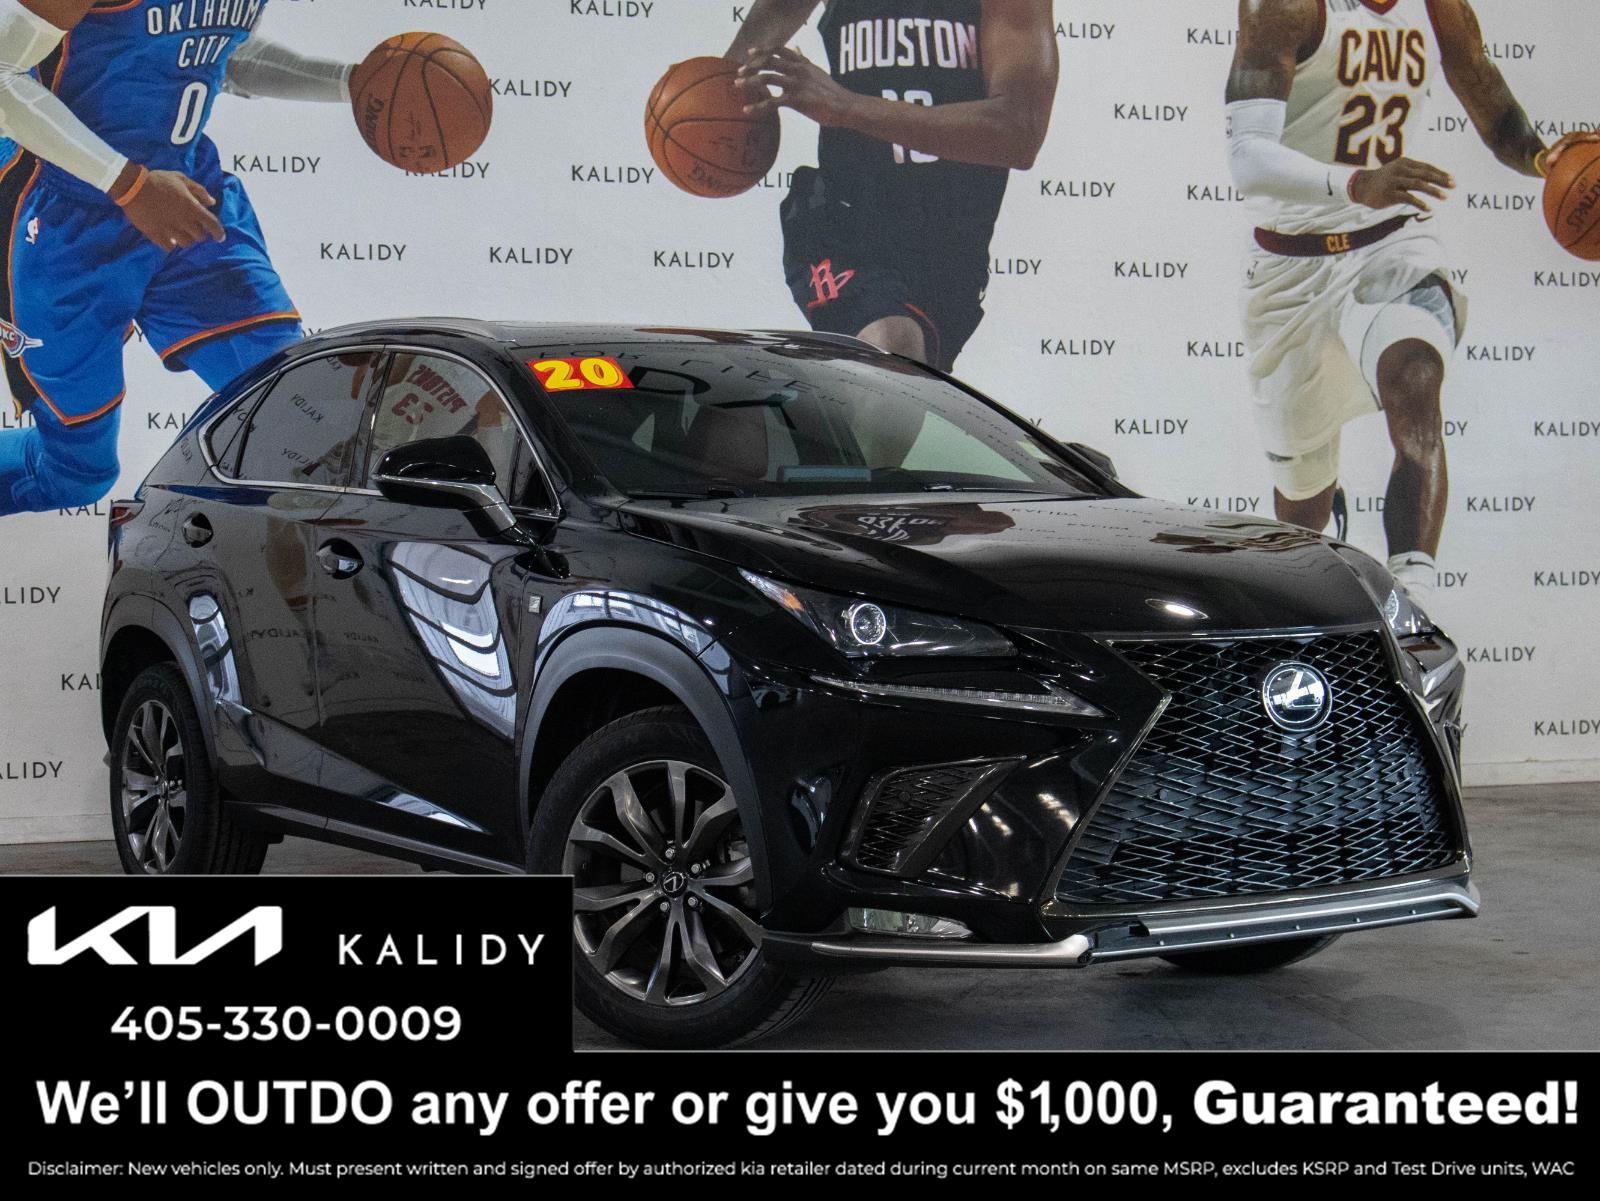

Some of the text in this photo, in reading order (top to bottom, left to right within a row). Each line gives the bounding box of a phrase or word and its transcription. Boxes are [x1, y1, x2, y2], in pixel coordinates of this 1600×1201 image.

[570, 0, 653, 17] KALIDY
[1055, 22, 1116, 39] ALIDY
[1187, 28, 1239, 45] KALI
[178, 35, 230, 68] CITY
[839, 18, 978, 75] HOUSTON
[1482, 43, 1536, 59] ALIDY
[1337, 28, 1426, 88] CAVS
[489, 79, 572, 97] KALIDY
[170, 81, 208, 145] 0
[1115, 103, 1188, 122] KALIDY
[1334, 92, 1411, 167] 23
[233, 155, 320, 174] KALIDY
[572, 165, 654, 184] KALIDY
[1041, 180, 1115, 198] KALIDY
[1467, 194, 1536, 211] KALIDY
[320, 243, 406, 261] KALIDY
[1326, 235, 1350, 252] CLE
[490, 247, 573, 265] KALIDY
[654, 251, 734, 268] KALIDY
[988, 258, 1042, 275] LIDY
[1115, 262, 1188, 281] KALIDY
[1534, 271, 1600, 287] KALIDY
[1041, 339, 1115, 357] KALIDY
[1187, 342, 1245, 358] KALID
[1467, 346, 1536, 362] KALIDY
[533, 359, 624, 389] 20
[1115, 418, 1188, 436] KALIDY
[1534, 421, 1600, 437] KALIDY
[1467, 496, 1536, 513] KALIDY
[1534, 571, 1600, 587] KALIDY
[0, 586, 61, 604] LIDY
[1467, 646, 1536, 662] KALIDY
[1534, 719, 1600, 736] KALIDY
[0, 760, 63, 779] LIDY
